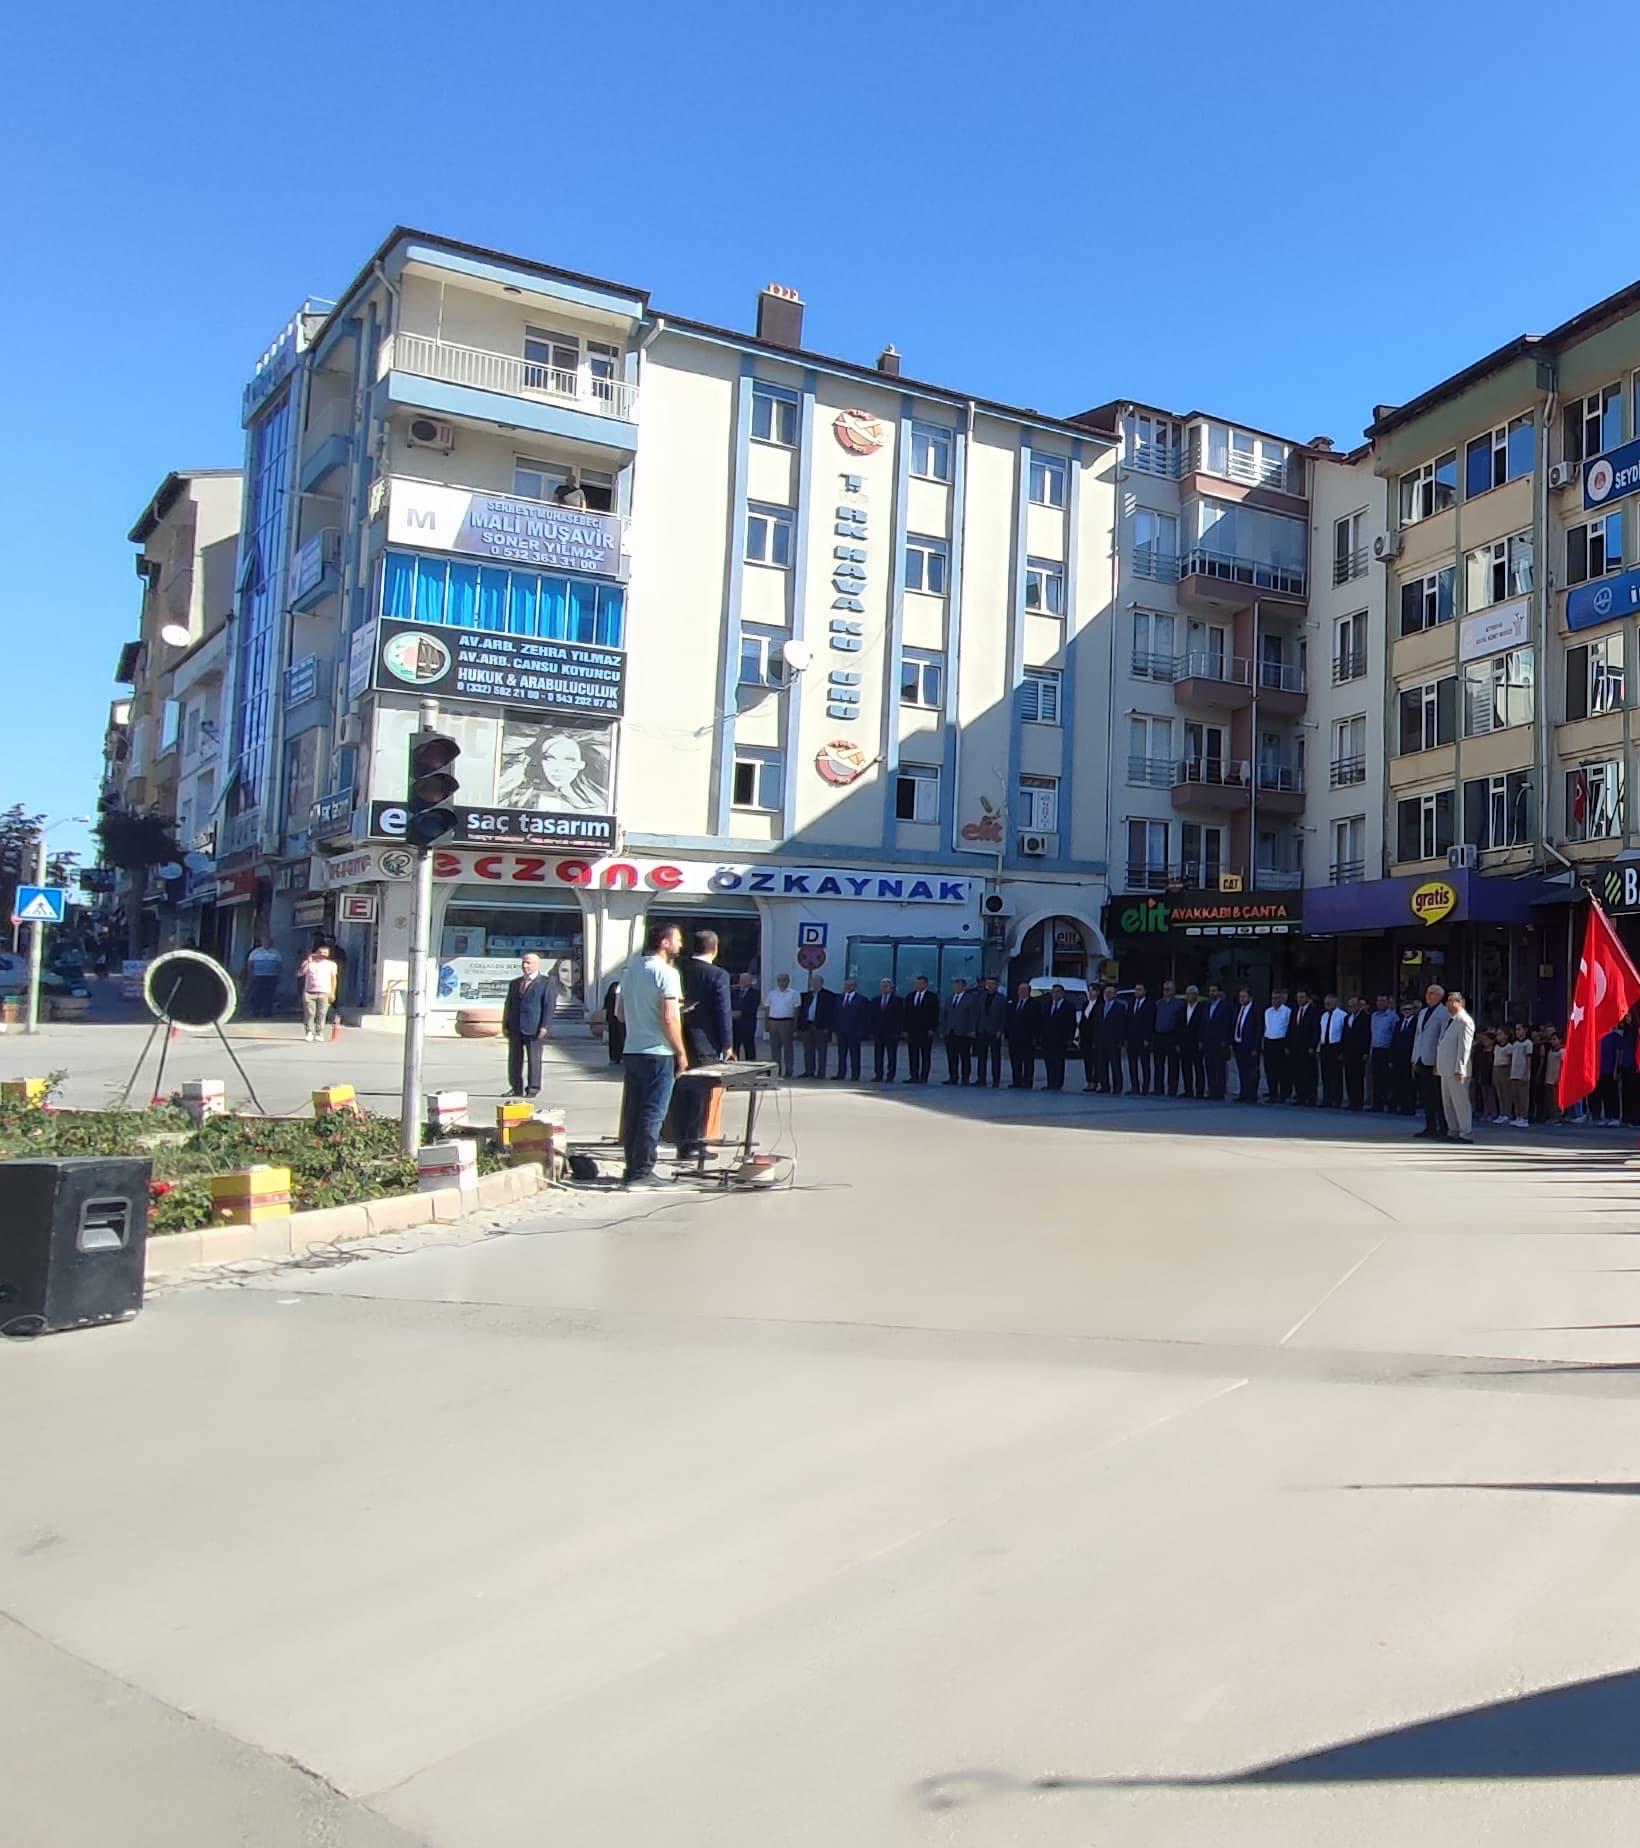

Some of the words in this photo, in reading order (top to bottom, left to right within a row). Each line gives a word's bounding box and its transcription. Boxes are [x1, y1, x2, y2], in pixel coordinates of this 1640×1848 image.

[406, 508, 436, 530] M
[471, 511, 521, 534] MALİ
[528, 518, 615, 549] MÜŞAVİR
[481, 532, 541, 551] SONER
[543, 541, 605, 562] YILMAZ
[503, 548, 529, 561] 532
[831, 545, 868, 613] HAVA
[520, 643, 567, 660] ZEHRA
[571, 650, 622, 667] YILMAZ
[513, 658, 558, 675] CANSU
[561, 664, 621, 682] KOYUNCU
[458, 668, 505, 685] HUKUK
[507, 673, 517, 687] &
[520, 675, 619, 699] ARABULUCULUK
[467, 813, 511, 833] saç
[518, 813, 610, 838] tasarım
[712, 866, 965, 900] ÖZKAYNAK
[1223, 878, 1239, 890] CAT
[350, 901, 368, 916] E
[1415, 886, 1450, 912] gratis
[1121, 897, 1170, 934] elit
[1171, 906, 1232, 920] AYAKKABI
[1242, 904, 1287, 919] ÇANTA
[806, 928, 819, 943] D
